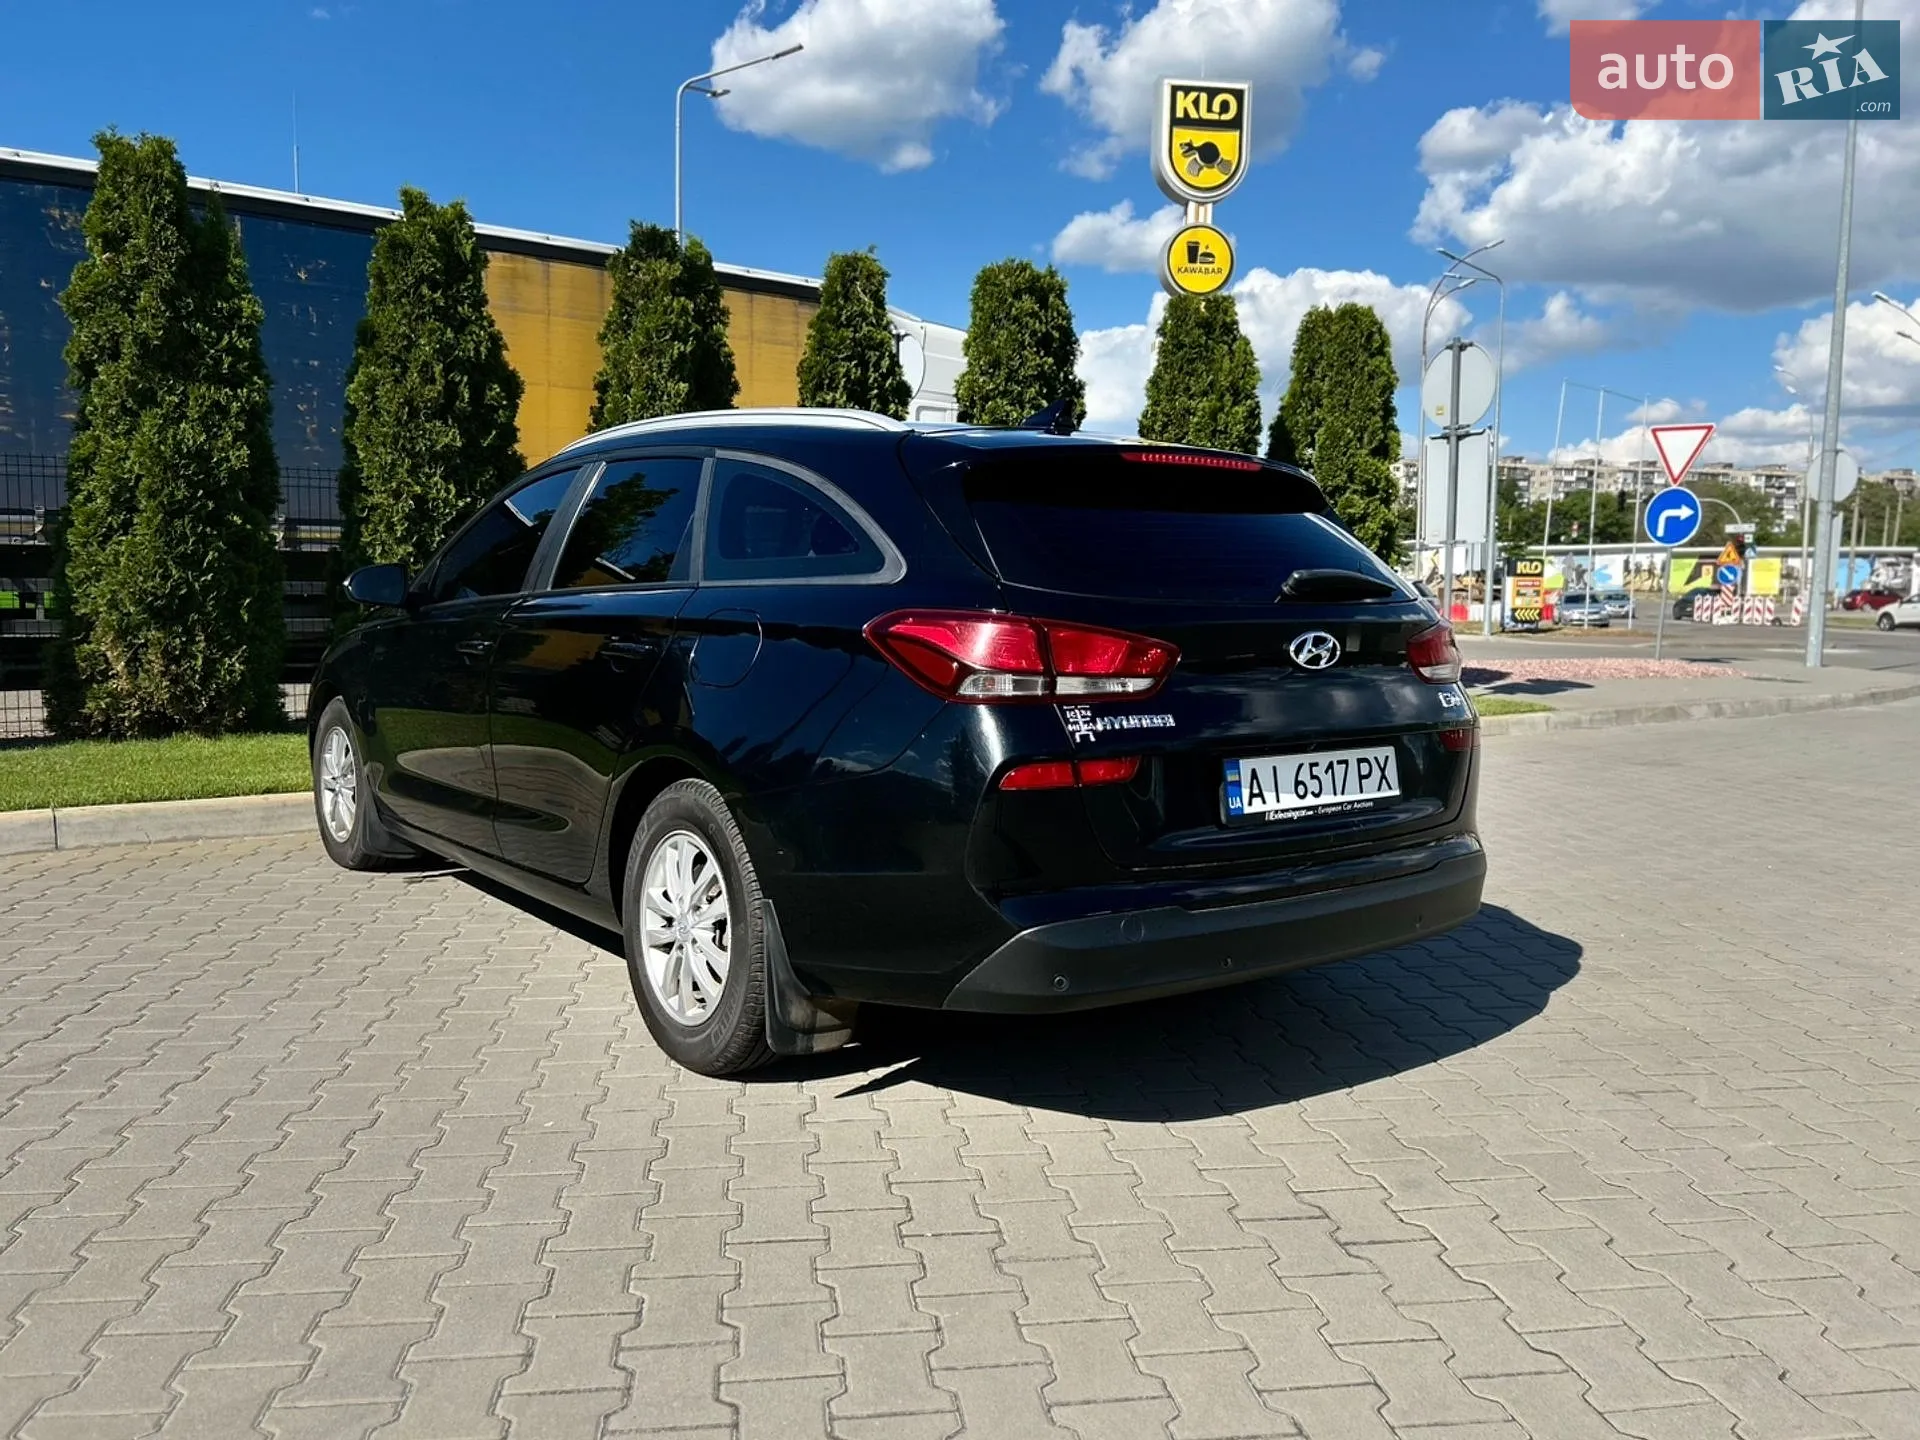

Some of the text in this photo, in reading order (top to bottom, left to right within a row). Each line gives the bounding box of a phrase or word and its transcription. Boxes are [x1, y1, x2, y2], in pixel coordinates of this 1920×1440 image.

[1175, 90, 1238, 121] KLO
[1176, 265, 1223, 276] KAWABAR
[1516, 560, 1543, 575] KLO
[1247, 755, 1393, 807] AI 6517 PX
[1229, 797, 1243, 809] UA
[1342, 802, 1352, 811] Car
